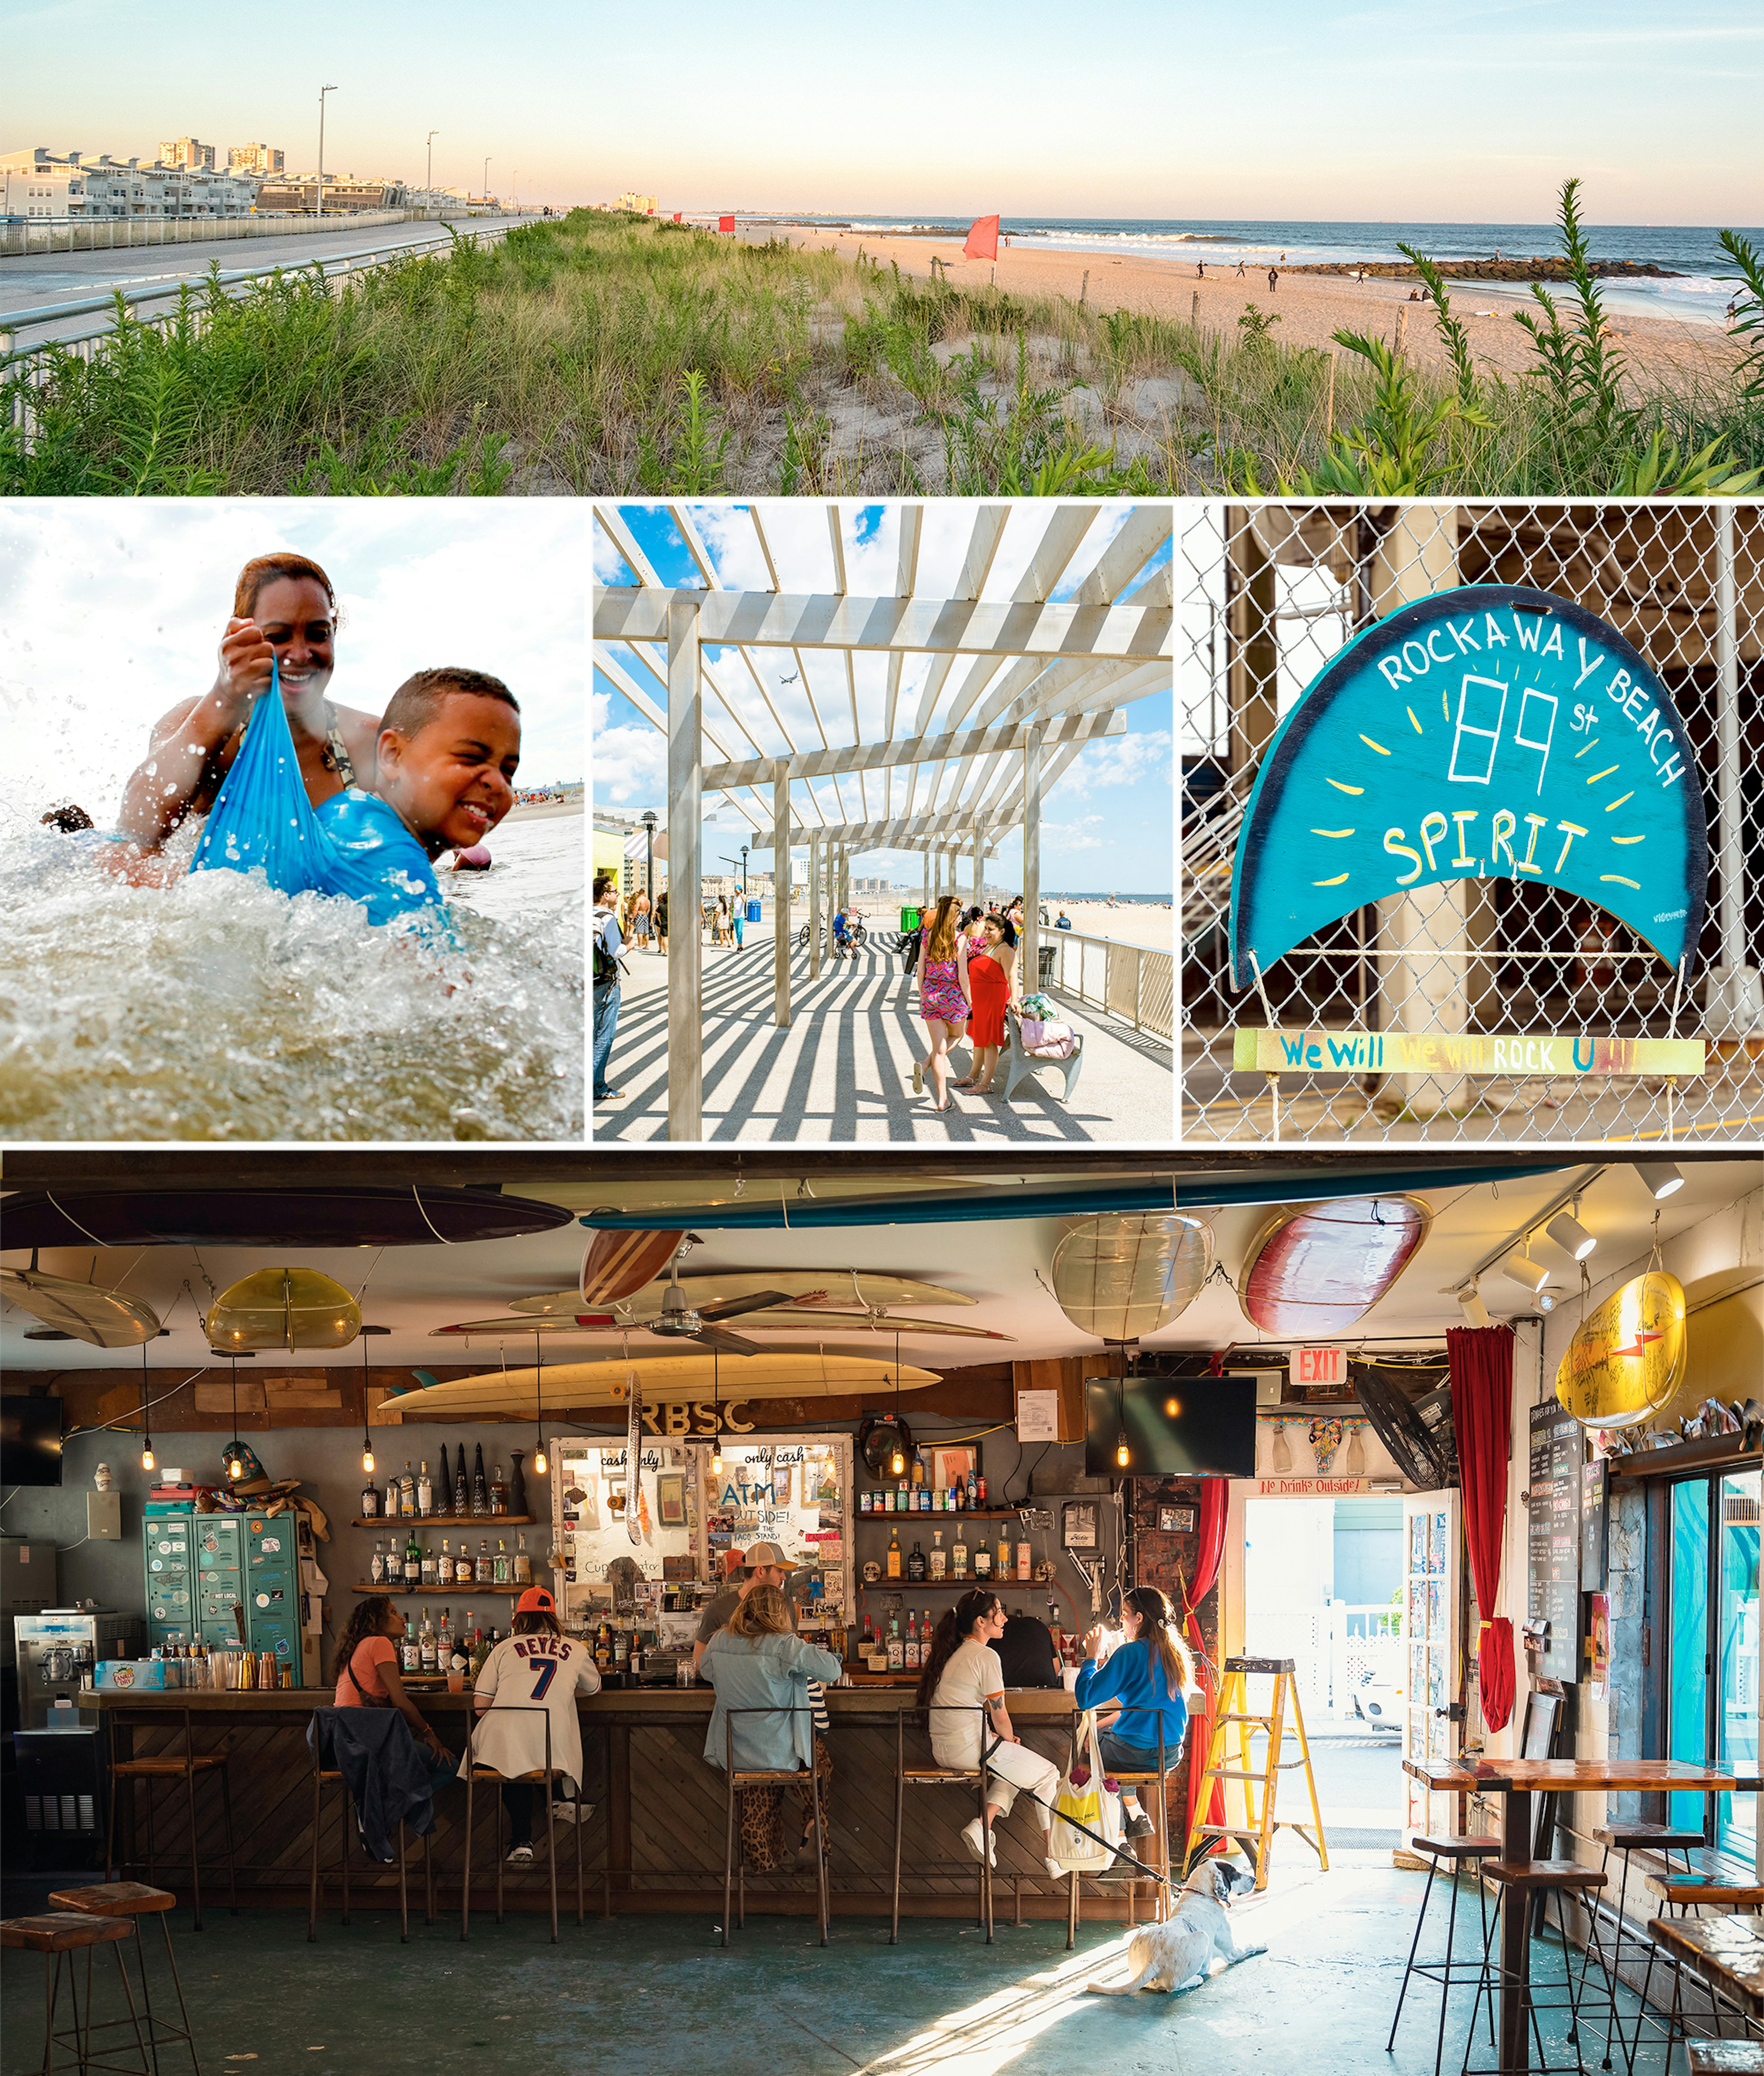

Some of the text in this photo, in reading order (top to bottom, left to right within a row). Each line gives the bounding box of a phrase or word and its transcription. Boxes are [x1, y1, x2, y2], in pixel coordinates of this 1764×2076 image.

[1377, 612, 1686, 789] ROCKAWAY BEACH
[1447, 674, 1558, 797] 89
[1383, 808, 1588, 886] SPIRIT
[1280, 1034, 1322, 1068] We
[1327, 1036, 1384, 1068] Will
[1399, 1038, 1438, 1069] We
[1445, 1038, 1484, 1070] Will
[1493, 1038, 1556, 1071] ROCK
[1572, 1038, 1595, 1072] U
[1300, 1349, 1340, 1381] EXIT
[642, 1399, 756, 1435] RBSC
[601, 1450, 659, 1472] cash nly
[745, 1446, 804, 1470] only cash
[721, 1482, 776, 1506] ATM
[1261, 1478, 1360, 1494] No Drinks Outside!
[733, 1532, 780, 1541] TACO STAND!
[585, 1561, 609, 1575] Cup
[406, 1651, 413, 1659] Q
[513, 1636, 572, 1661] REYES
[893, 1649, 899, 1657] Q
[908, 1648, 915, 1657] Q
[530, 1658, 557, 1701] 7
